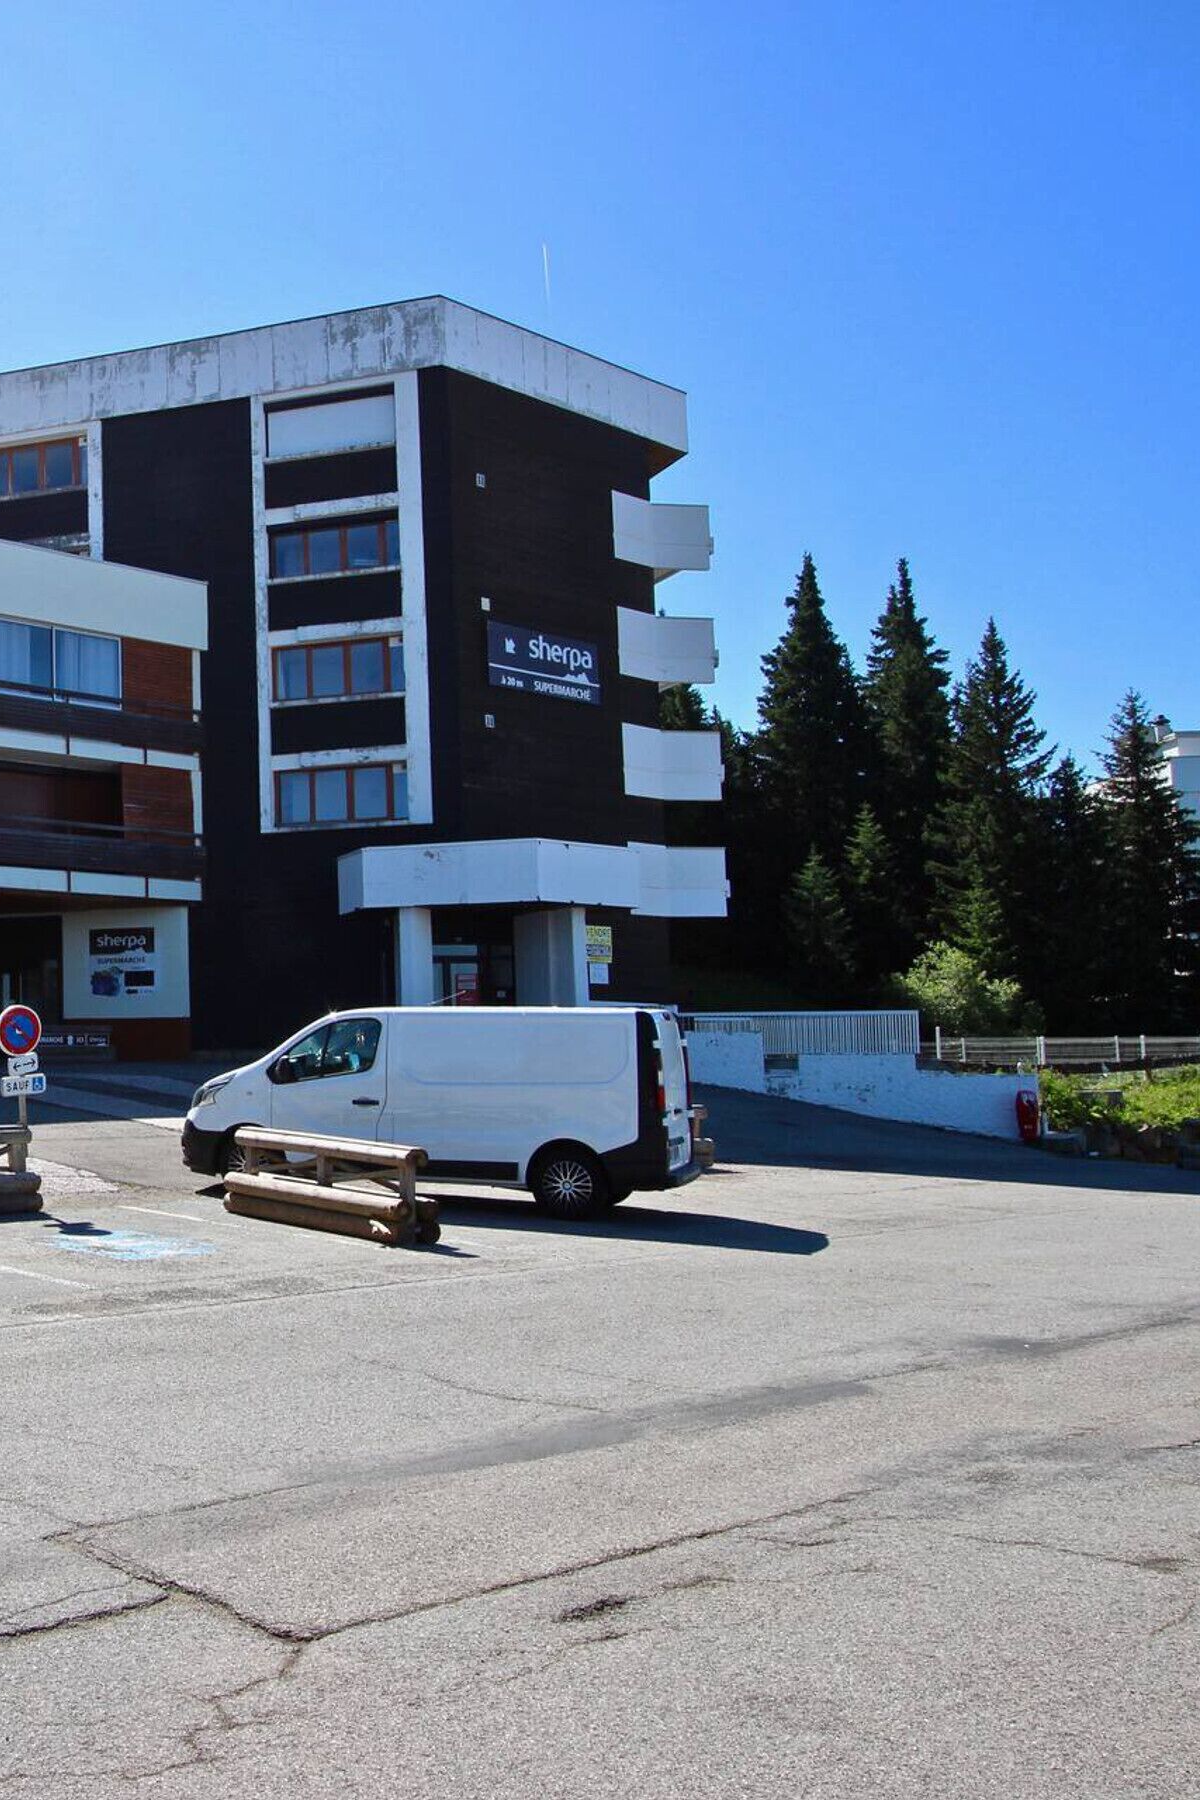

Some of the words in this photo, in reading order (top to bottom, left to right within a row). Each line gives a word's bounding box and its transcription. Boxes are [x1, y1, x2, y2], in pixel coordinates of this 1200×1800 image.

[528, 635, 592, 670] sherpa
[96, 933, 146, 948] sherpa
[6, 1080, 30, 1092] SAUF
